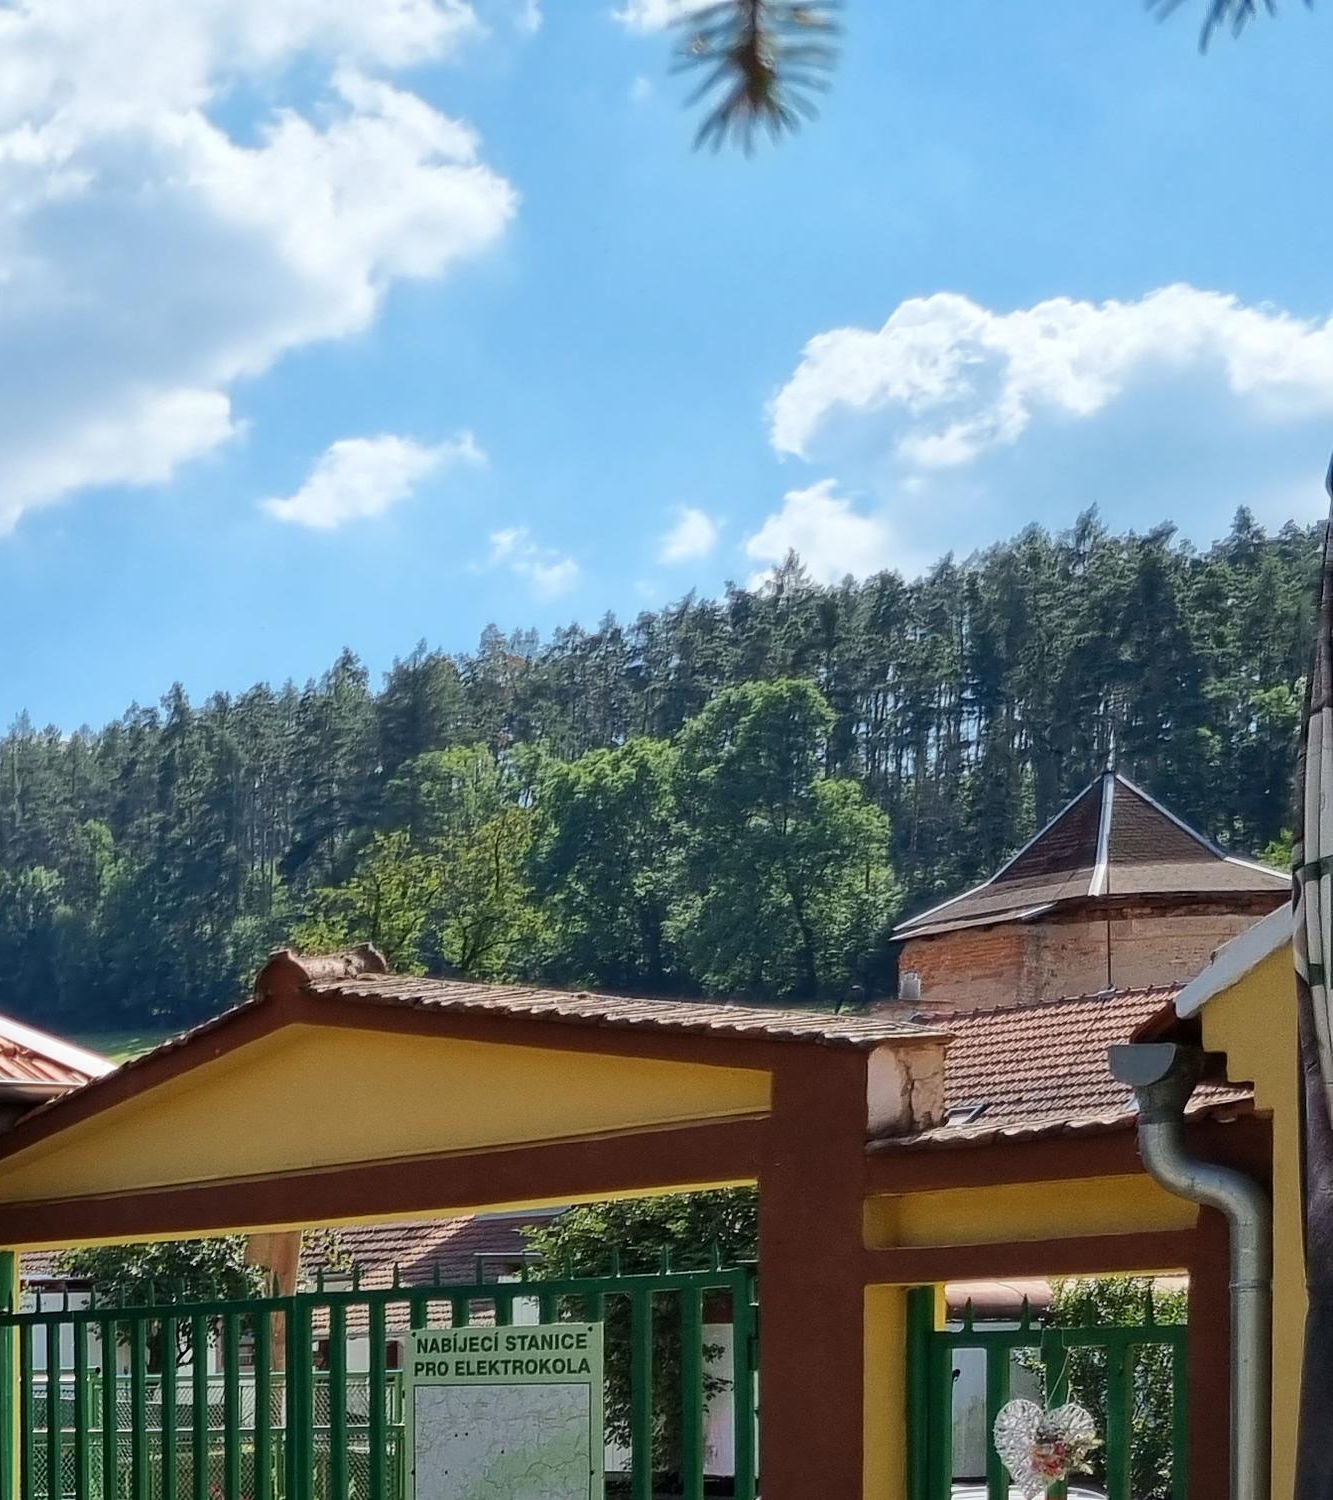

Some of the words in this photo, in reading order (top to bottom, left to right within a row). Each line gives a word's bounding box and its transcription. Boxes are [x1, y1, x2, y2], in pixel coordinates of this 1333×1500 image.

[416, 1332, 499, 1354] NABÍJECÍ
[505, 1333, 588, 1352] STANICE
[414, 1361, 449, 1377] PRO
[454, 1358, 591, 1376] ELEKTROKOLA
